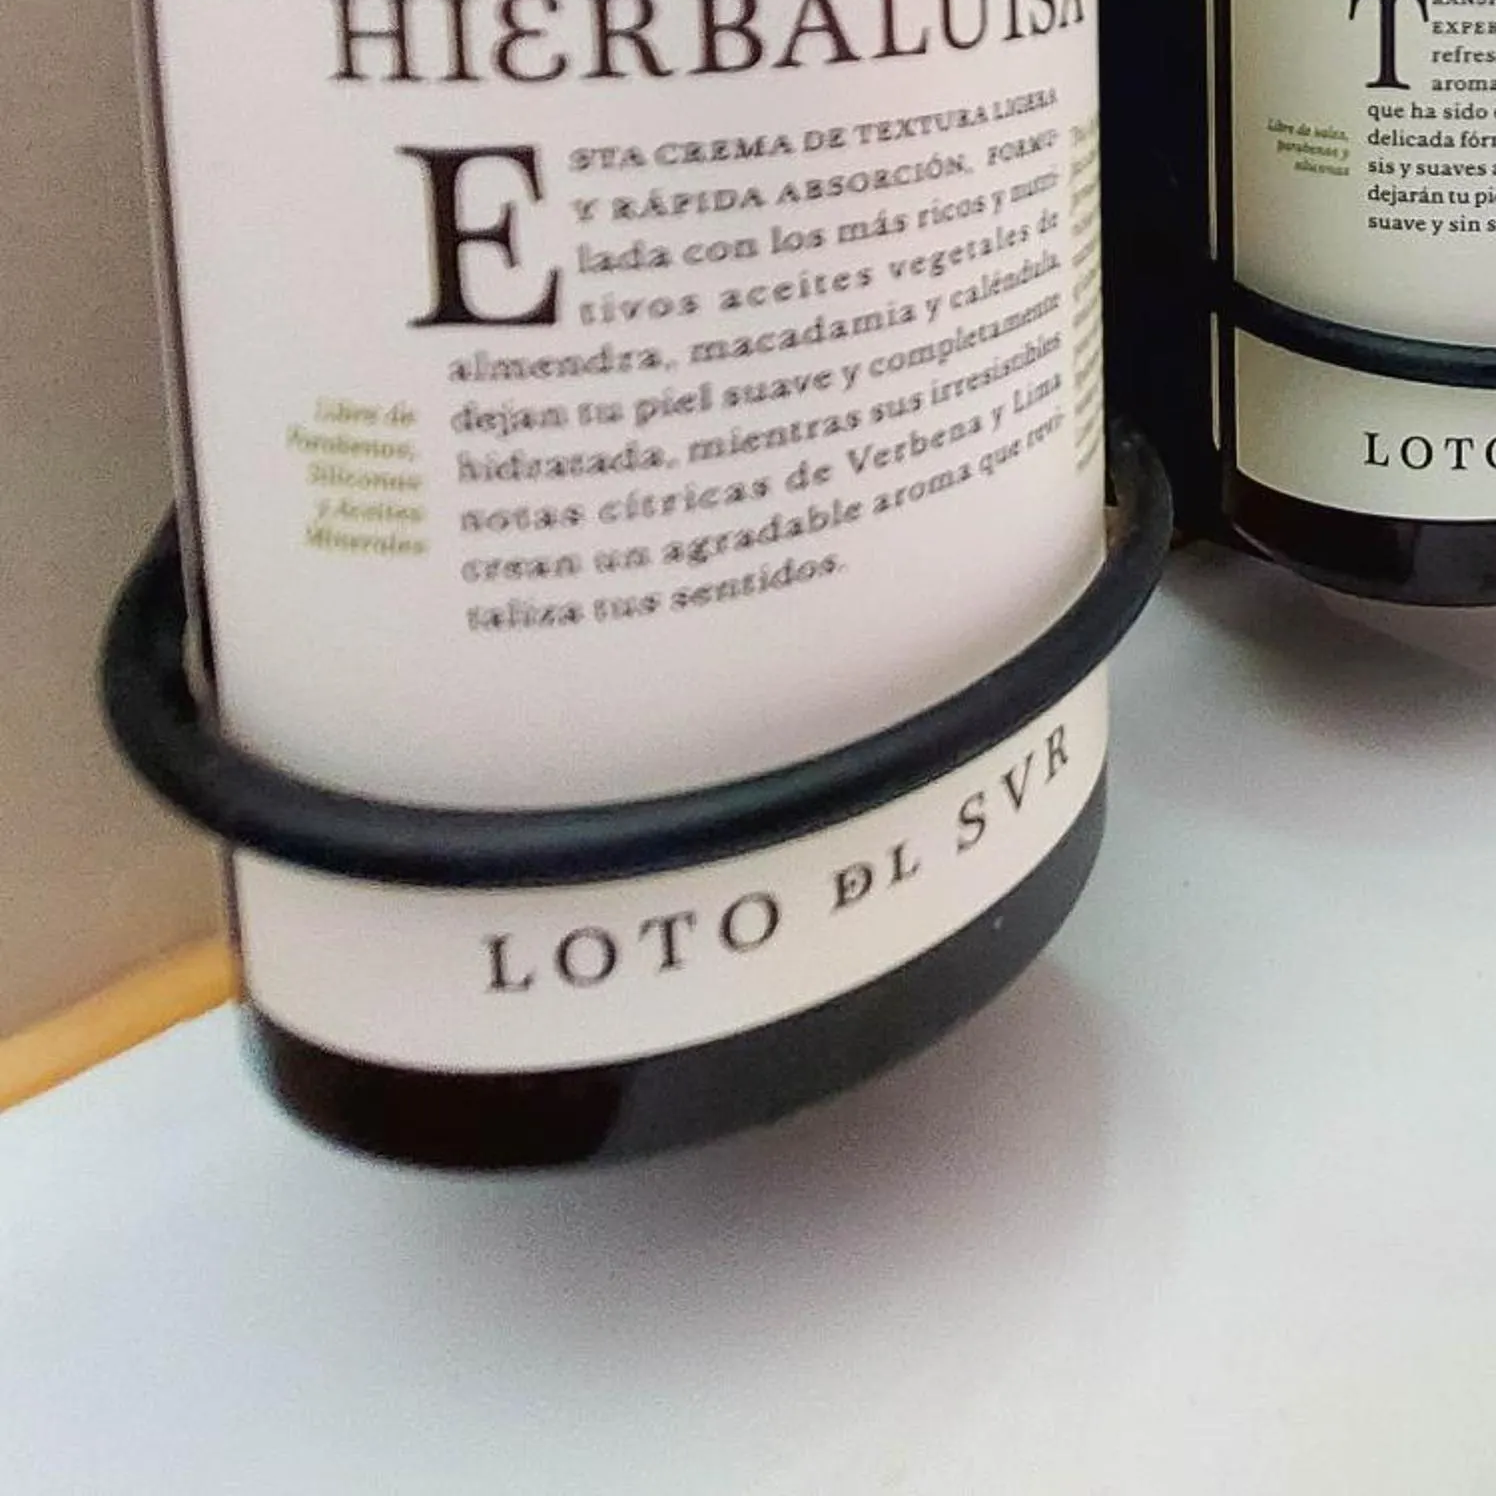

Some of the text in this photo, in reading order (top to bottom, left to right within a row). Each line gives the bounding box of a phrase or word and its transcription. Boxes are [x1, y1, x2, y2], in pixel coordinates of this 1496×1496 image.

[654, 134, 795, 166] CREMA
[804, 127, 847, 152] DE
[854, 105, 989, 144] TEXTURA
[1367, 104, 1405, 121] que
[1410, 102, 1436, 119] ha
[1442, 102, 1489, 120] sido
[1367, 128, 1455, 148] delicada
[1367, 157, 1395, 175] sis
[1400, 162, 1412, 179] y
[1415, 162, 1487, 177] suaves
[1367, 184, 1445, 206] dejarán
[1448, 189, 1470, 205] tu
[574, 198, 599, 221] Y
[612, 187, 767, 220] RÁPIDA
[577, 238, 673, 274] lada
[683, 237, 759, 266] con
[770, 224, 826, 255] los
[838, 207, 909, 244] más
[917, 194, 987, 228] ricos
[992, 189, 1006, 215] y
[1367, 215, 1427, 232] suave
[1431, 217, 1445, 237] y
[1448, 215, 1481, 232] sin
[579, 207, 1059, 326] tivos aceites vegetales de
[690, 301, 917, 362] macadamia
[925, 294, 943, 323] y
[450, 292, 1061, 437] dejan tu piel suave y completamente
[460, 372, 1062, 533] notas cítricas de Verbena y Lima
[688, 409, 862, 463] mientras
[870, 391, 924, 424] sus
[460, 556, 581, 583] crean
[593, 545, 651, 574] un
[662, 498, 862, 566] agradable
[872, 461, 971, 515] aroma
[978, 438, 1022, 476] que
[593, 592, 662, 623] tus
[483, 892, 781, 994] LOTO
[955, 722, 1071, 853] SVR
